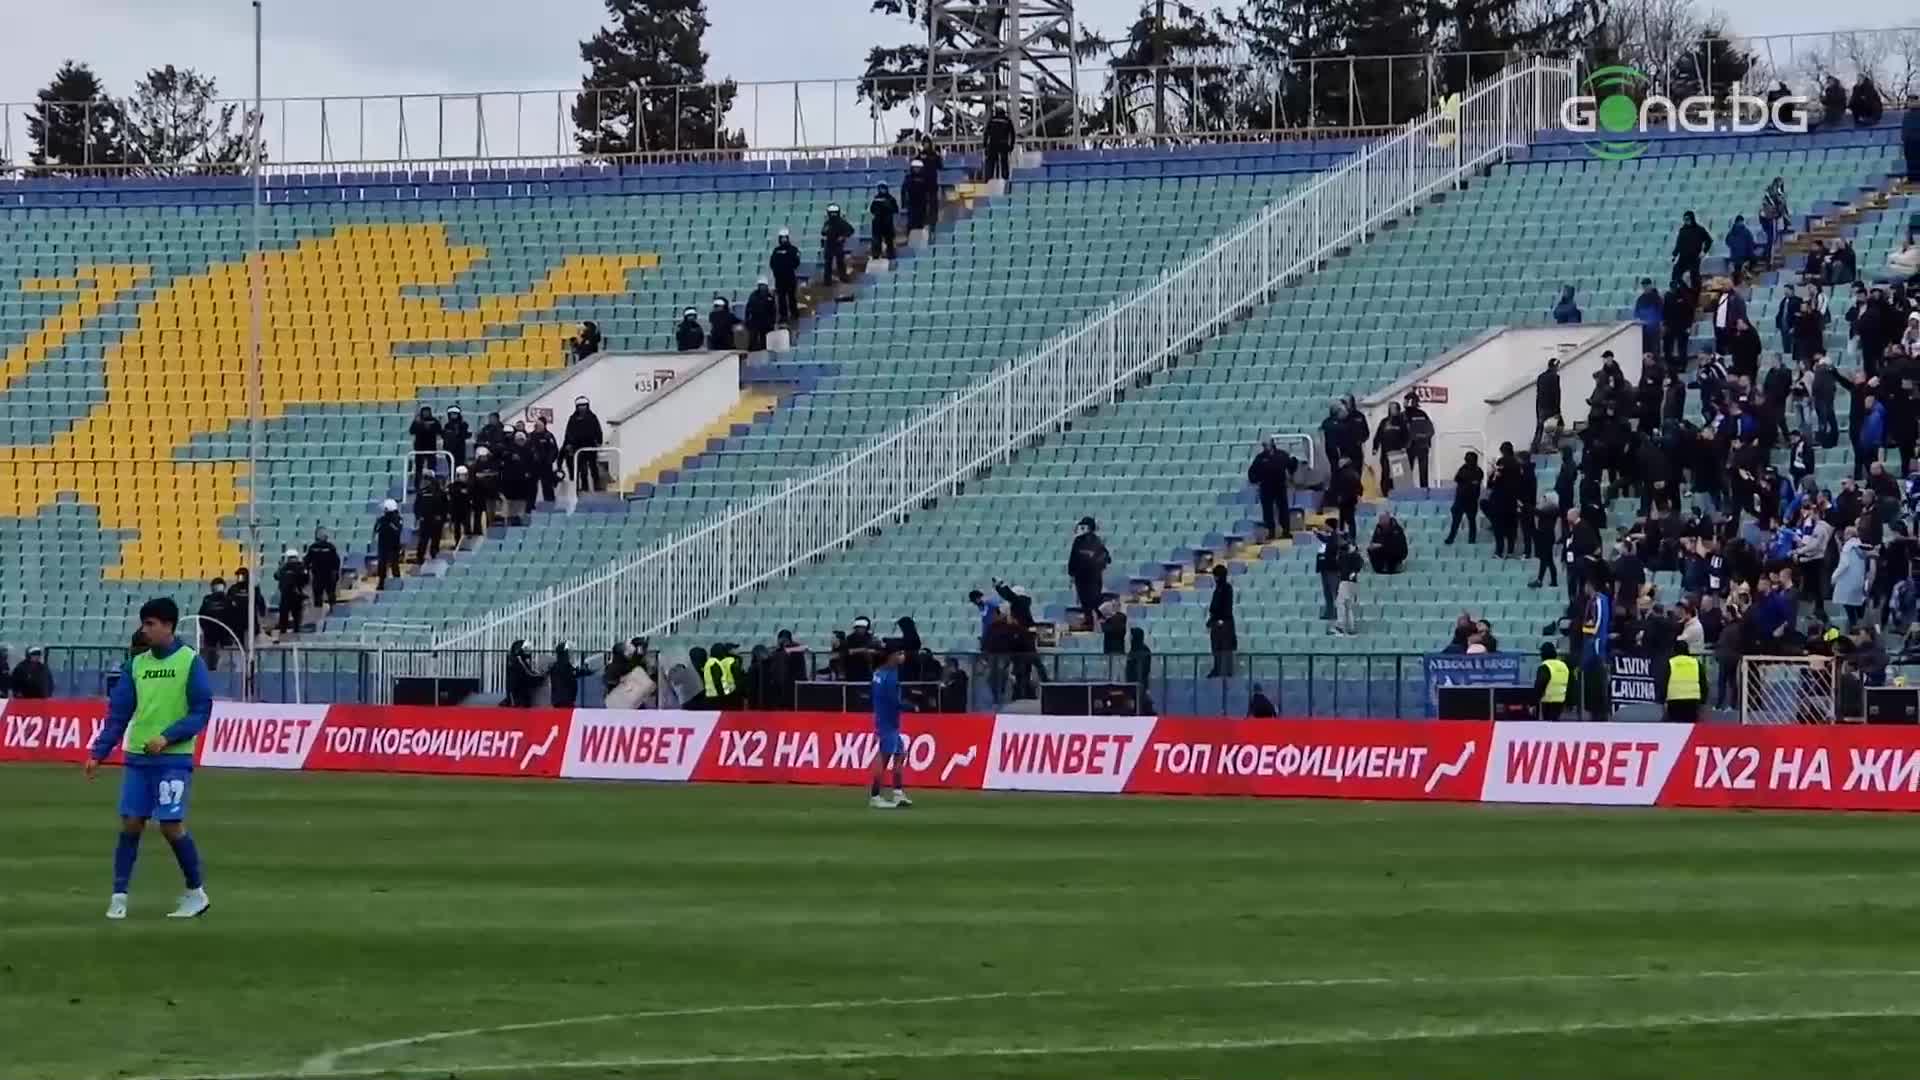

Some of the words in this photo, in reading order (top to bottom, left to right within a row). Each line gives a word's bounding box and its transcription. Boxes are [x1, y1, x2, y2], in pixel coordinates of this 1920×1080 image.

[1611, 680, 1656, 701] LAVINA
[46, 718, 81, 748] НА
[213, 718, 312, 754] WINBET
[324, 727, 367, 753] ТОП
[372, 730, 524, 760] КОЕФИЦИЕНТ
[579, 726, 694, 764] WINBET
[774, 731, 820, 768] НА
[999, 732, 1133, 775] WINBET
[1152, 742, 1211, 775] ТОП
[1217, 743, 1428, 782] КОЕФИЦИЕНТ
[1505, 741, 1659, 786] WINBET
[1769, 747, 1832, 790] НА
